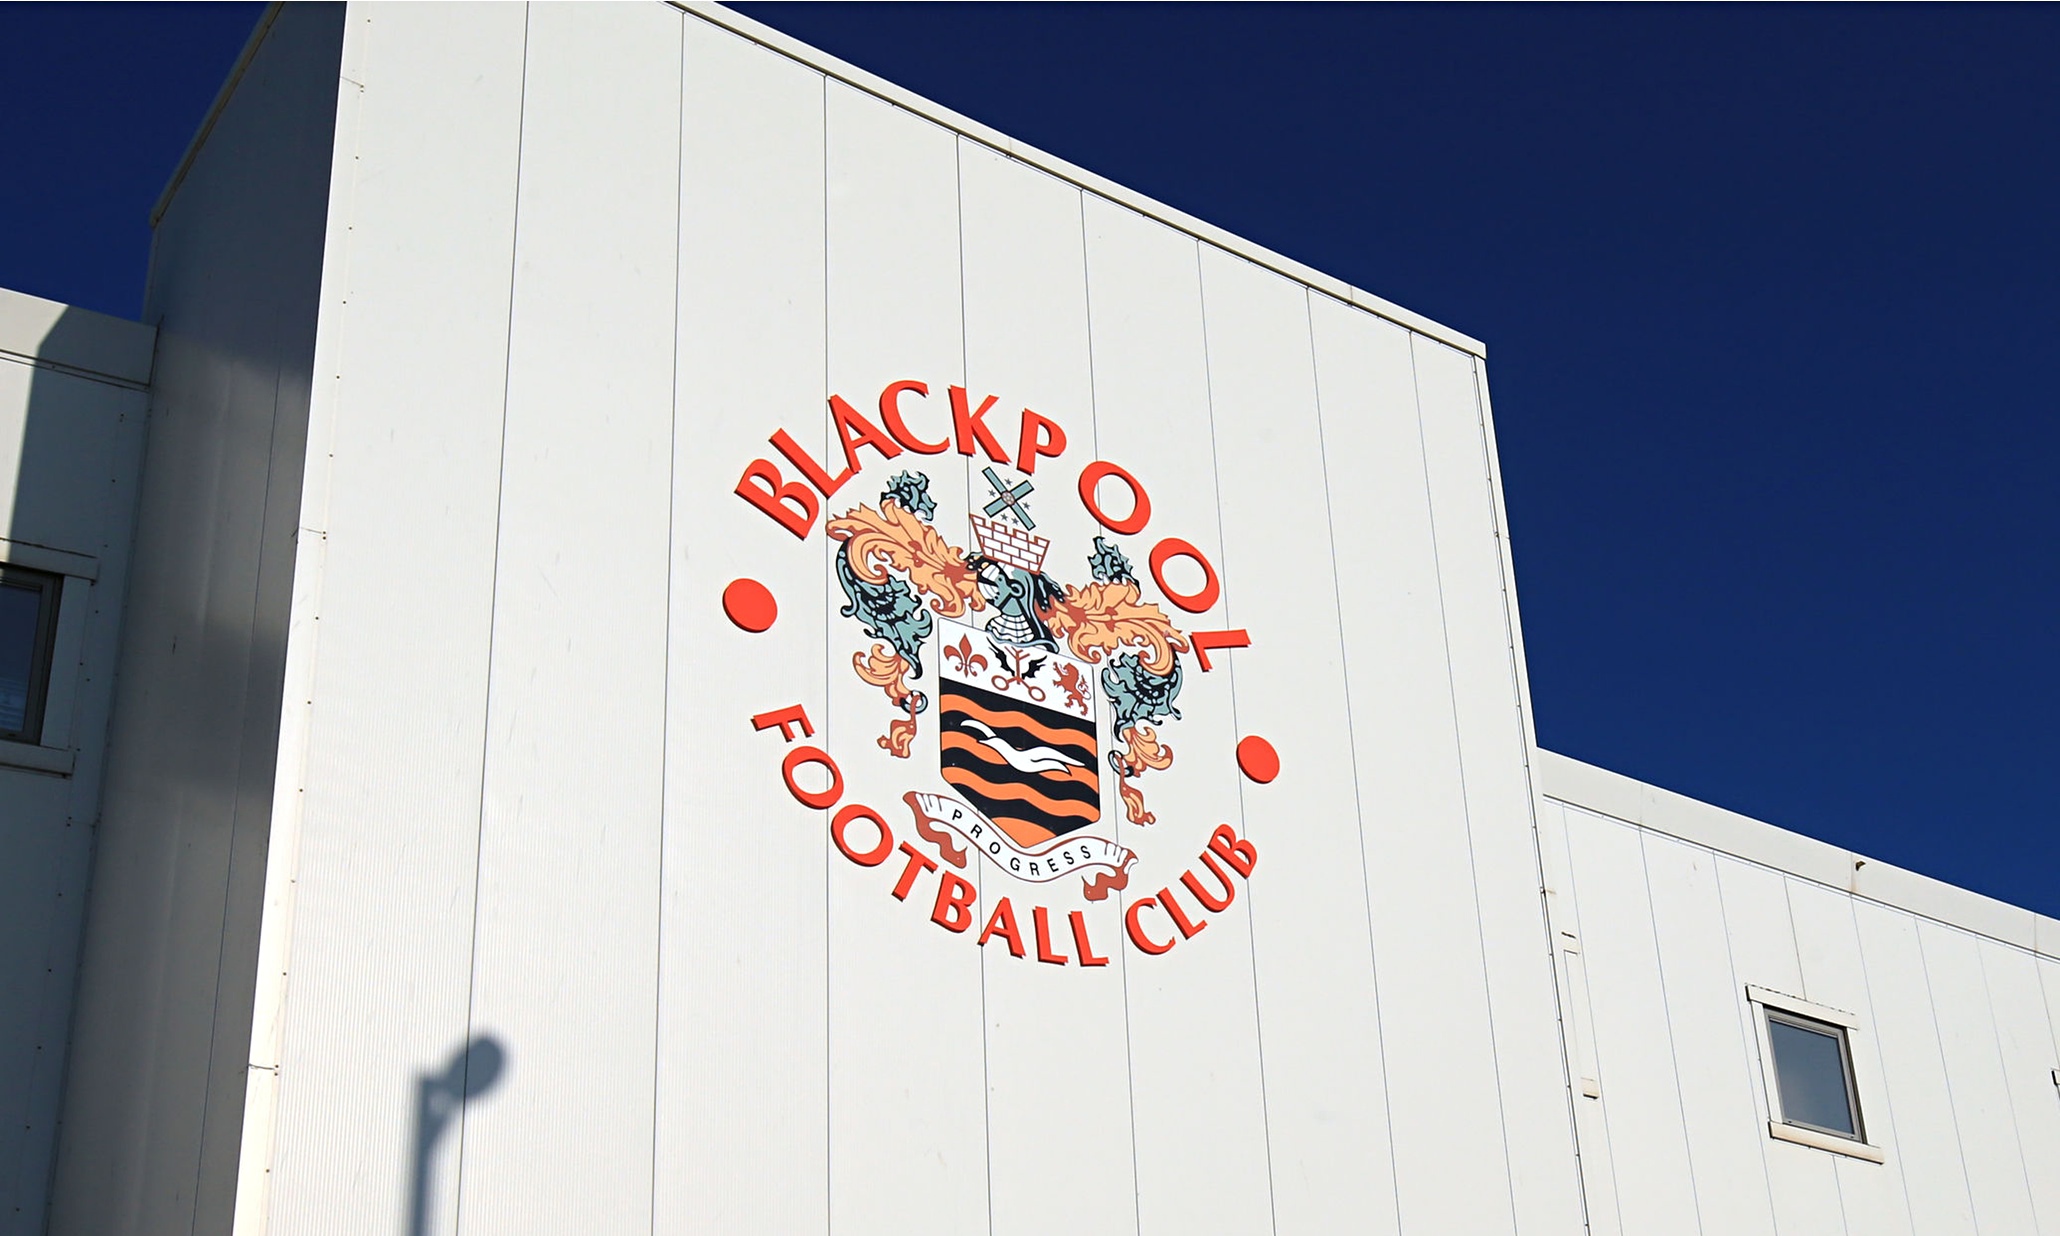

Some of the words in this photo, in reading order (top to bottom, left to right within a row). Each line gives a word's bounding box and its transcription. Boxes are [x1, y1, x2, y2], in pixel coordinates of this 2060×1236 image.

[734, 380, 1252, 673] BLACKPOOL
[751, 703, 1110, 968] FOOTBALL
[1125, 823, 1259, 956] CLUB
[951, 809, 1092, 876] PROGRESS
